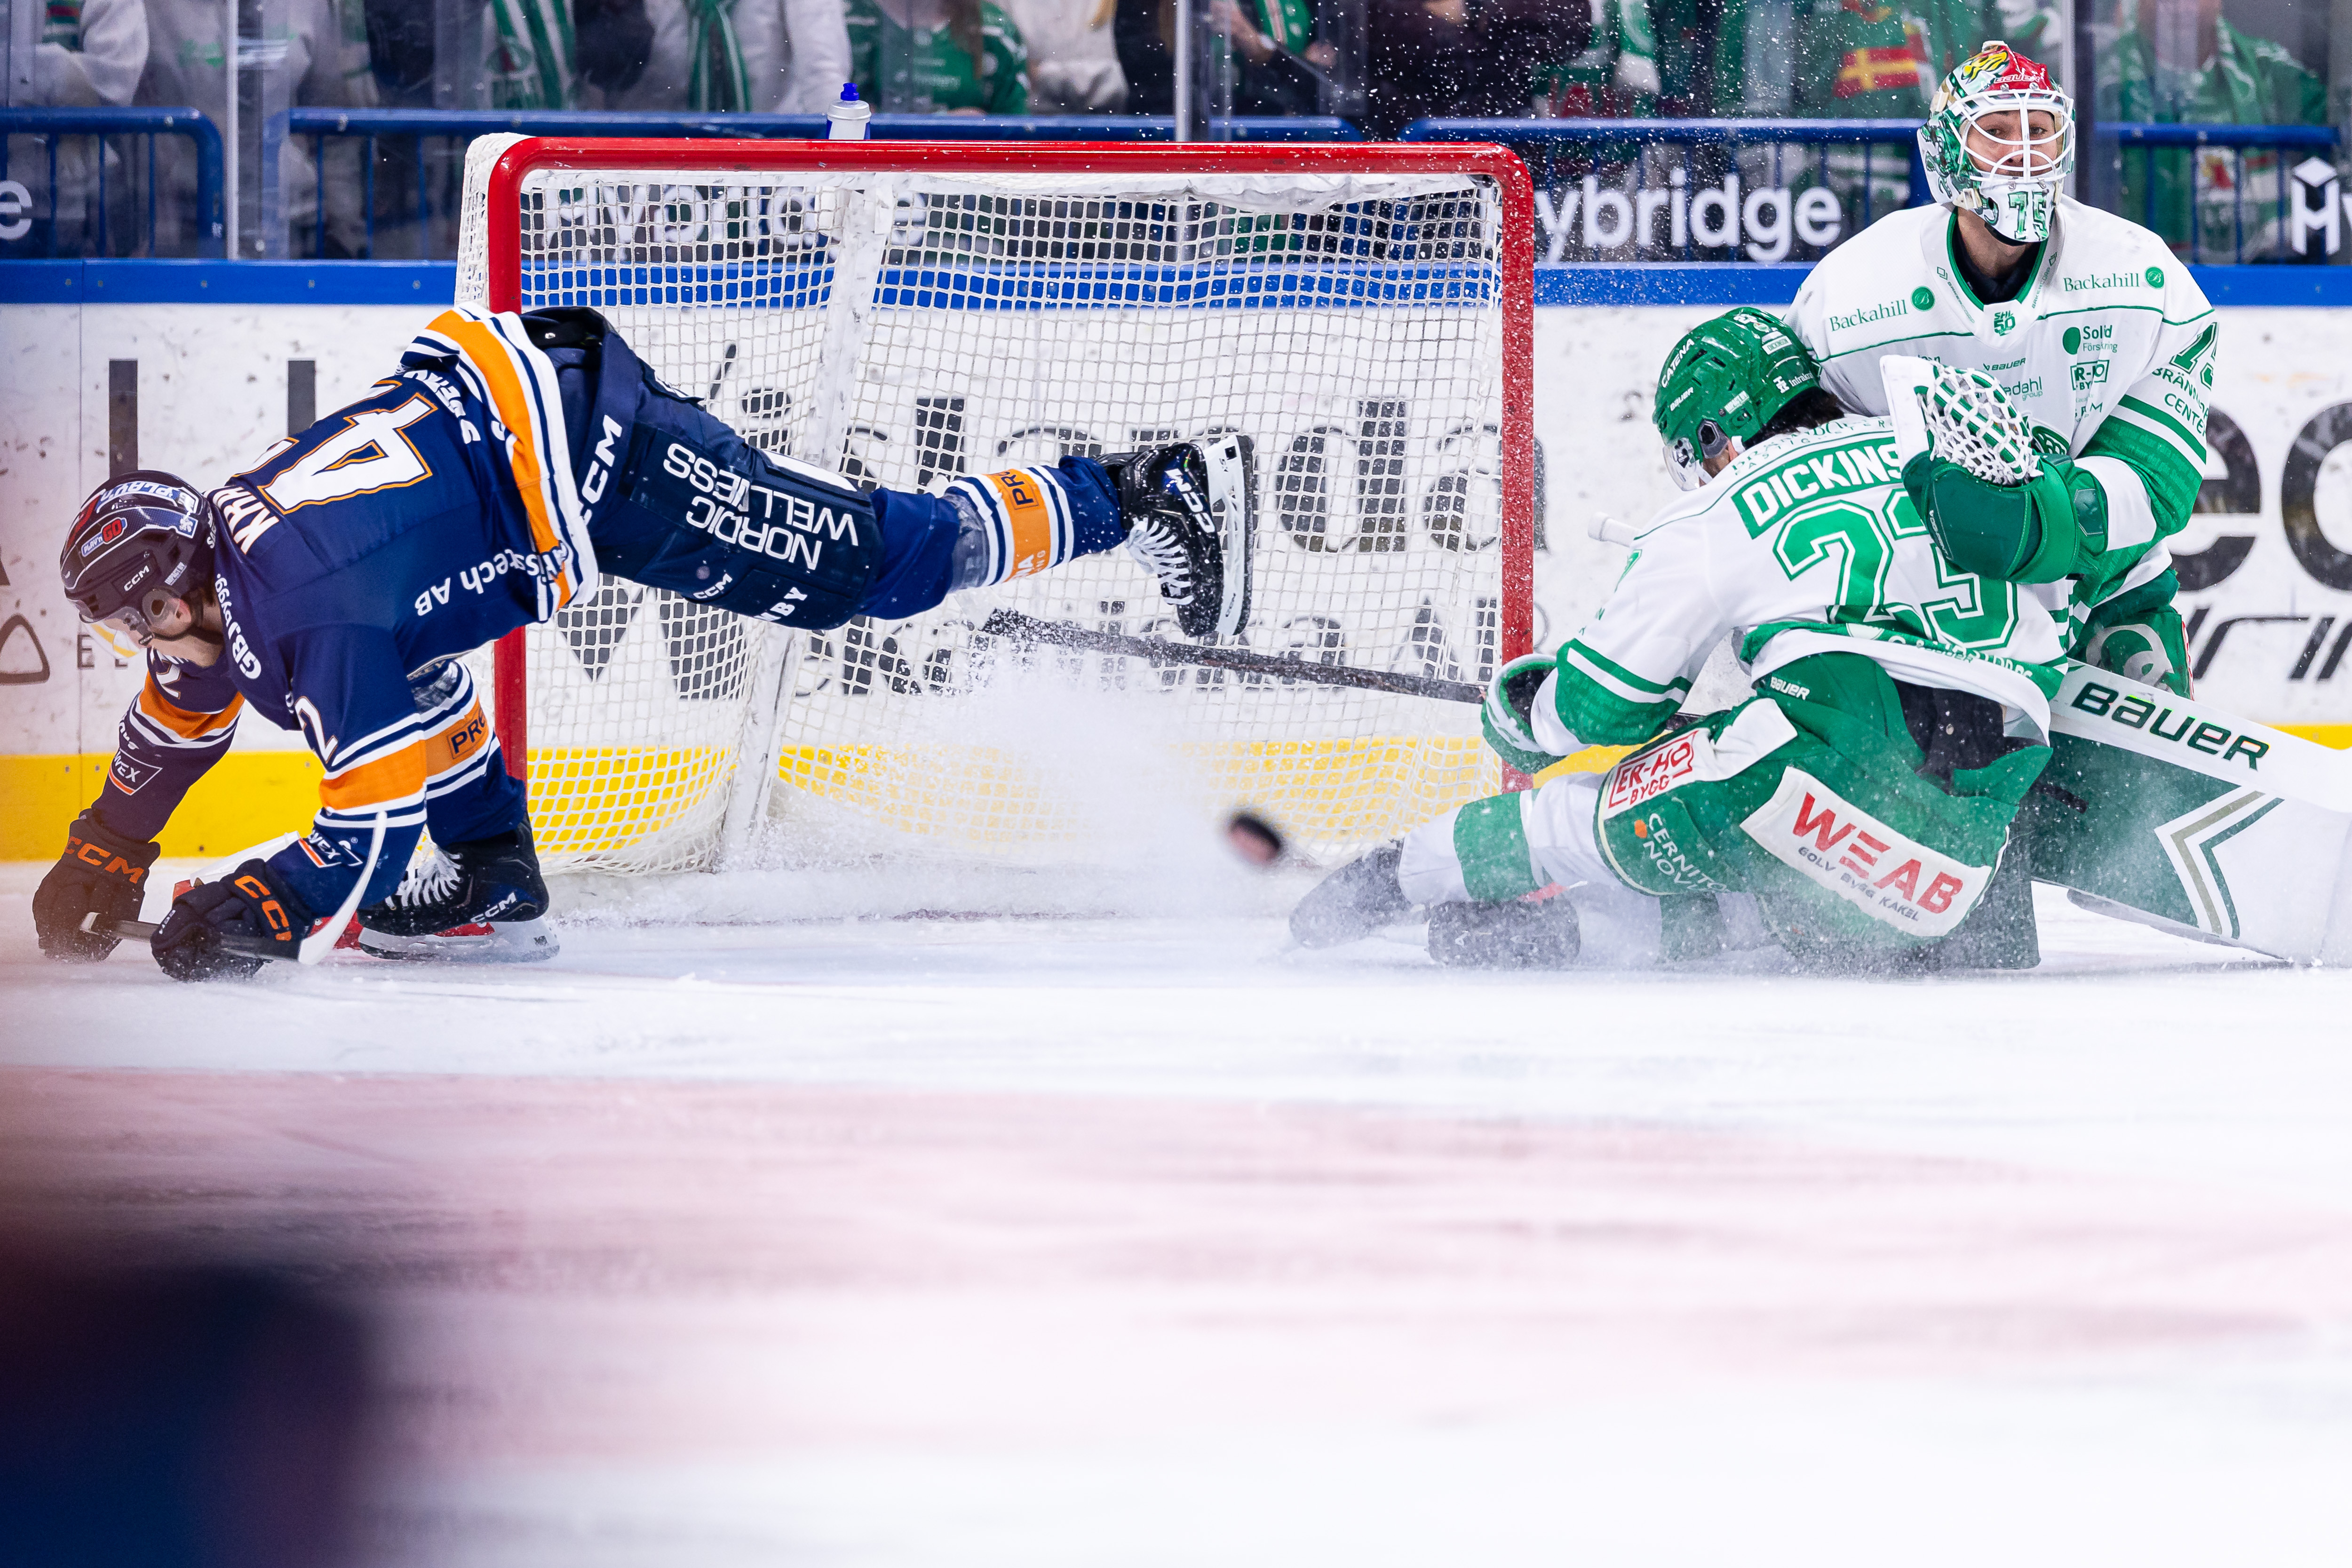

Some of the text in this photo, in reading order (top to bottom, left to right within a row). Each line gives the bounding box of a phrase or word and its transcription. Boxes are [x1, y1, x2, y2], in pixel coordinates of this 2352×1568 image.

[1534, 168, 1843, 264] ybridge
[2008, 191, 2049, 242] 75
[2064, 272, 2140, 293] Backahill
[1829, 299, 1908, 332] Backahill
[1661, 338, 1695, 389] CATENA
[1991, 357, 2026, 371] BAUER
[2021, 391, 2043, 401] group
[2164, 392, 2207, 438] CENTE
[1166, 468, 1216, 533] CCM
[1741, 443, 1902, 527] DICKINS
[102, 518, 123, 541] GO
[686, 495, 822, 570] NORDIC
[124, 565, 150, 592] CCM
[414, 577, 451, 617] AB
[693, 573, 733, 600] CCM
[1769, 676, 1811, 701] BAUER
[2070, 681, 2271, 772] BAUER
[1616, 741, 1691, 794] ER-HO
[1629, 774, 1670, 805] BYGG
[64, 835, 145, 885] CCM
[1792, 791, 1964, 914] WEAB
[1798, 846, 1836, 872] GOLV
